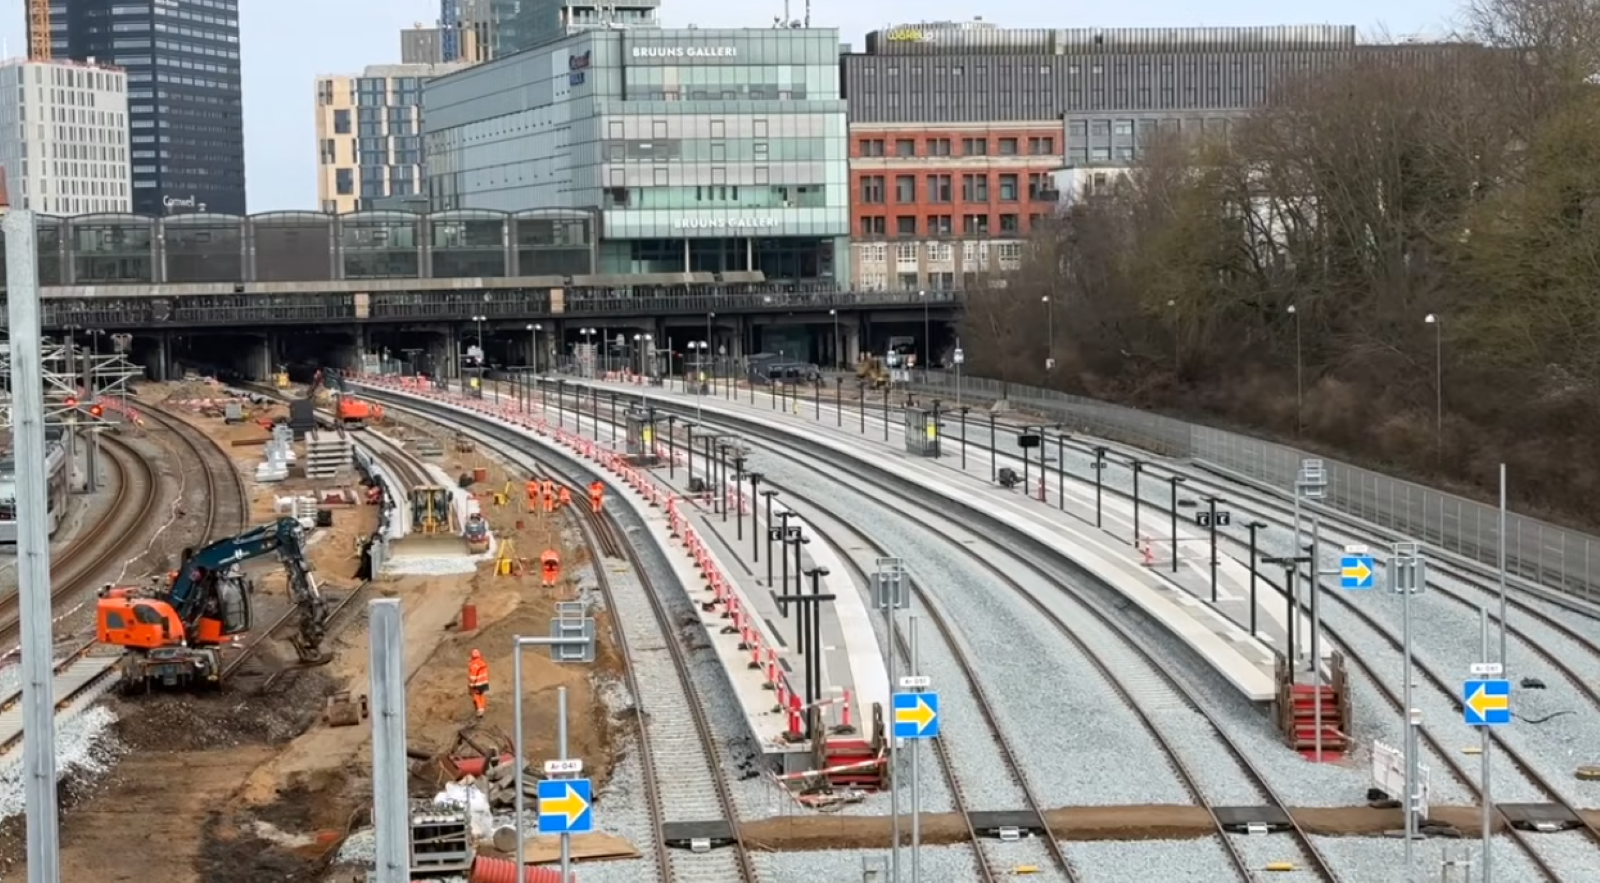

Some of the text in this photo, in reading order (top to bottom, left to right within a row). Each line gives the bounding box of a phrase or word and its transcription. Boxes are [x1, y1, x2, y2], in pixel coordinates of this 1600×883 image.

[633, 47, 738, 57] BRUUNS GALLERI
[674, 217, 779, 228] BRUUNS GALLERI
